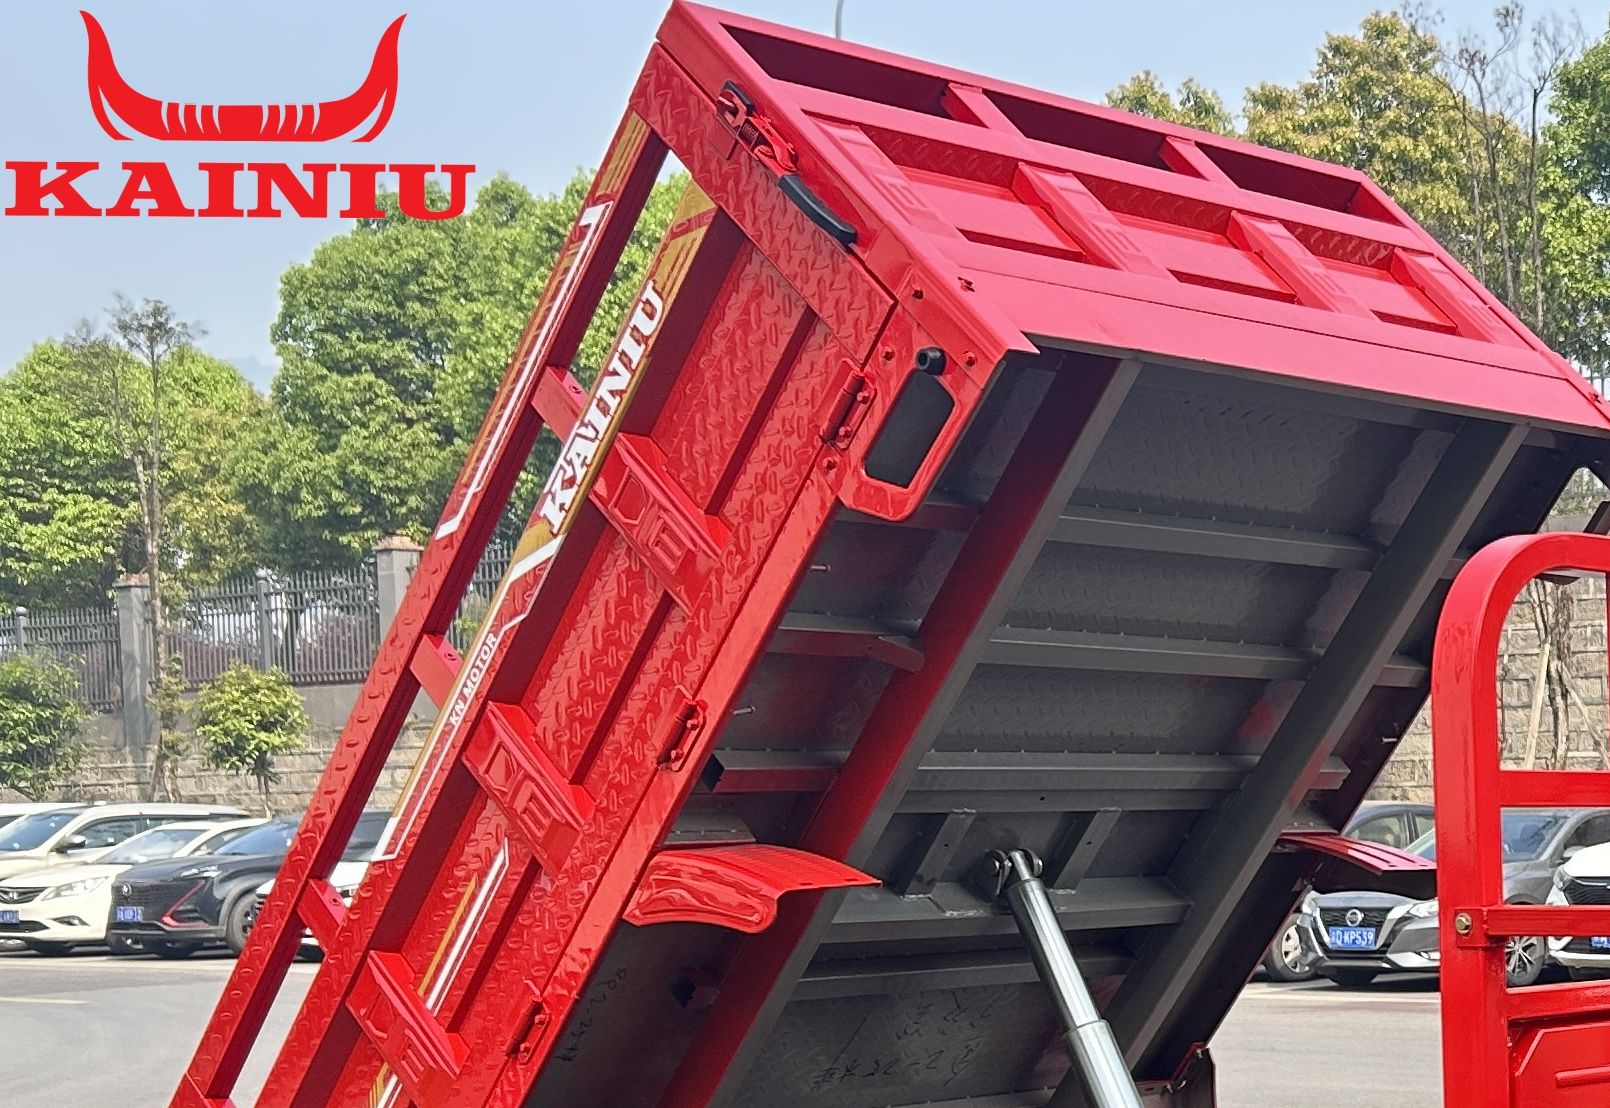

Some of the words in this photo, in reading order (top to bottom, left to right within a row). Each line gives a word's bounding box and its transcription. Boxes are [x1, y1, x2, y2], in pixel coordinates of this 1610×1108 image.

[539, 279, 665, 534] KAINIU
[449, 698, 466, 727] KN
[463, 632, 498, 698] MOTOR
